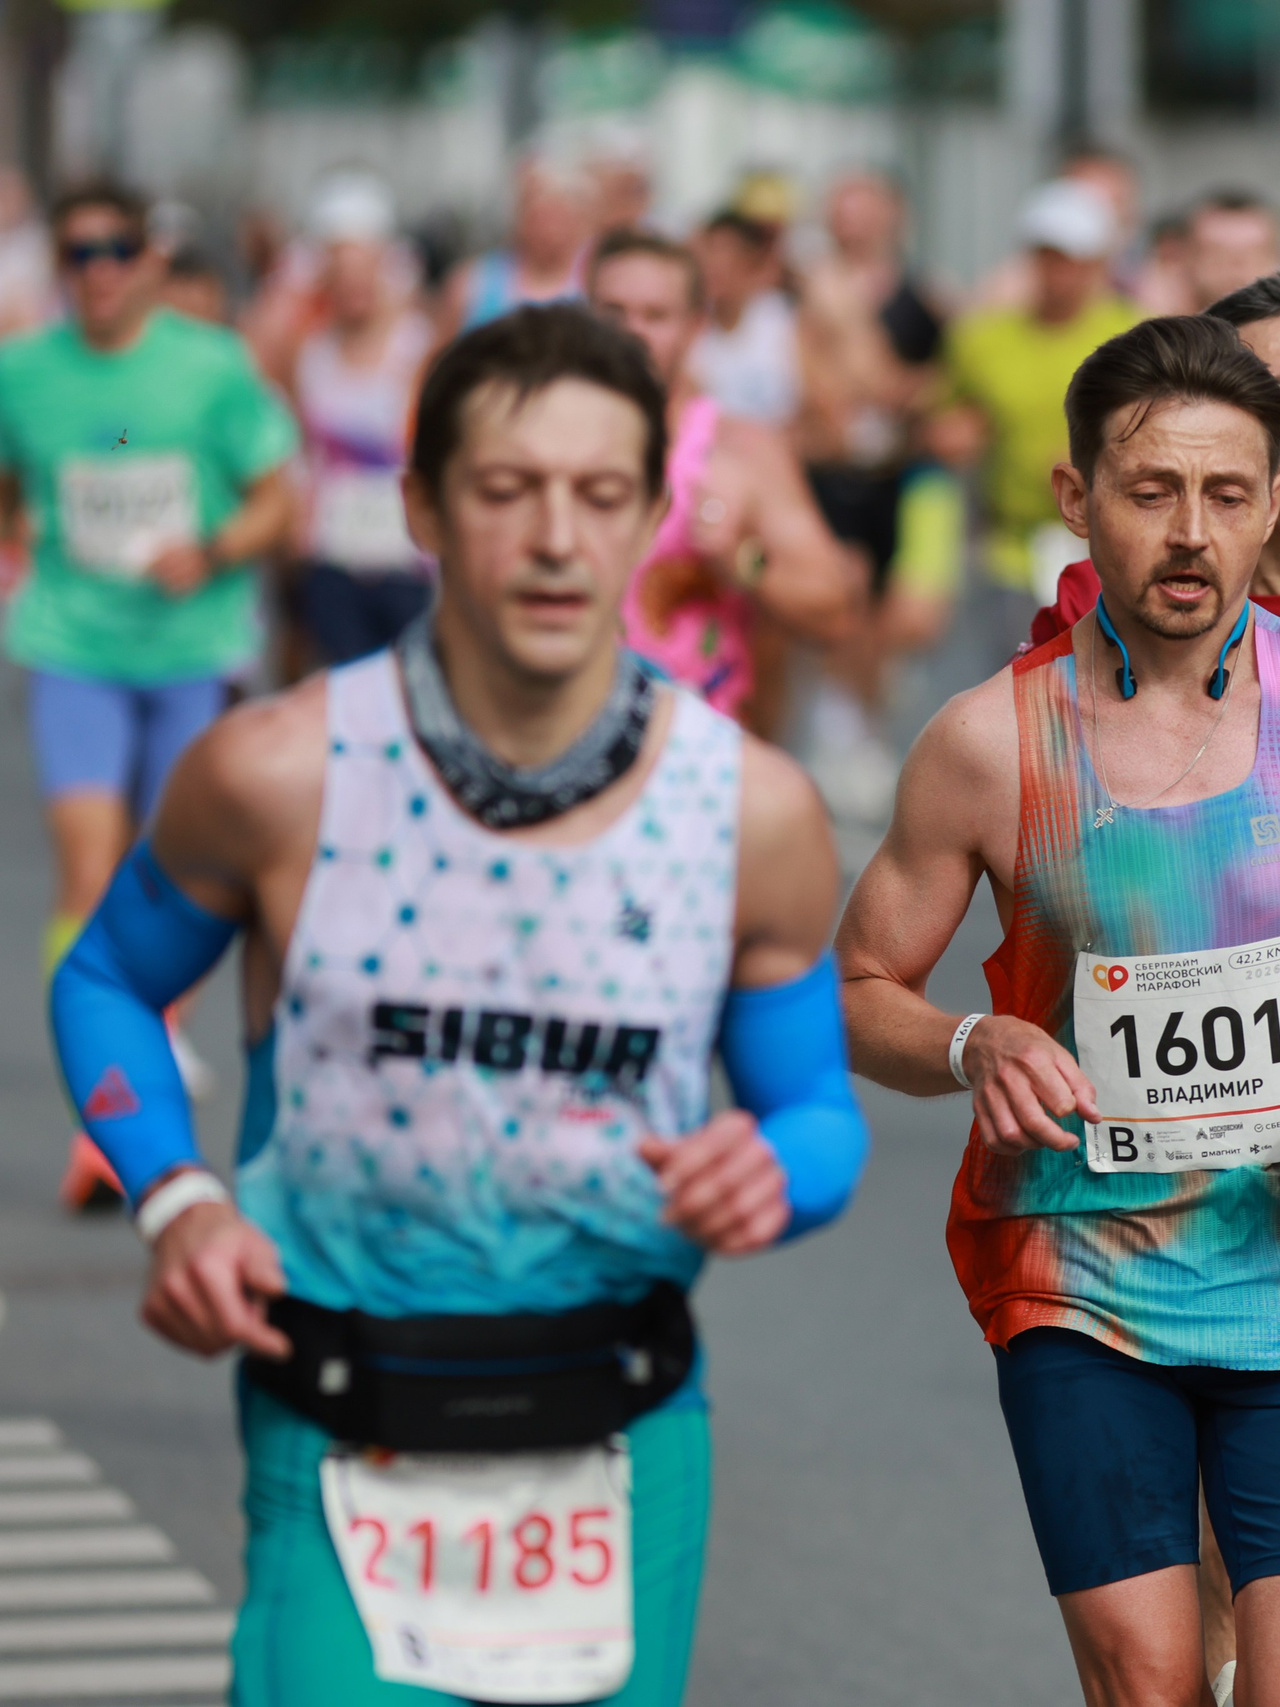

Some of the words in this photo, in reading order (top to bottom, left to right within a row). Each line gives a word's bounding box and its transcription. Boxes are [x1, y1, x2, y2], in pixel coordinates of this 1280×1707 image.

[1134, 958, 1199, 971] СБЕРПРАЙМ
[1236, 951, 1262, 965] 42,2
[1135, 963, 1223, 982] МОСКОВСКИЙ
[1245, 964, 1280, 980] 2026
[1136, 979, 1201, 992] МАРАФОН
[955, 1016, 978, 1043] 1601
[1146, 1078, 1264, 1104] ВЛАДИМИР
[1109, 1126, 1138, 1162] B
[350, 1506, 612, 1592] 21185
